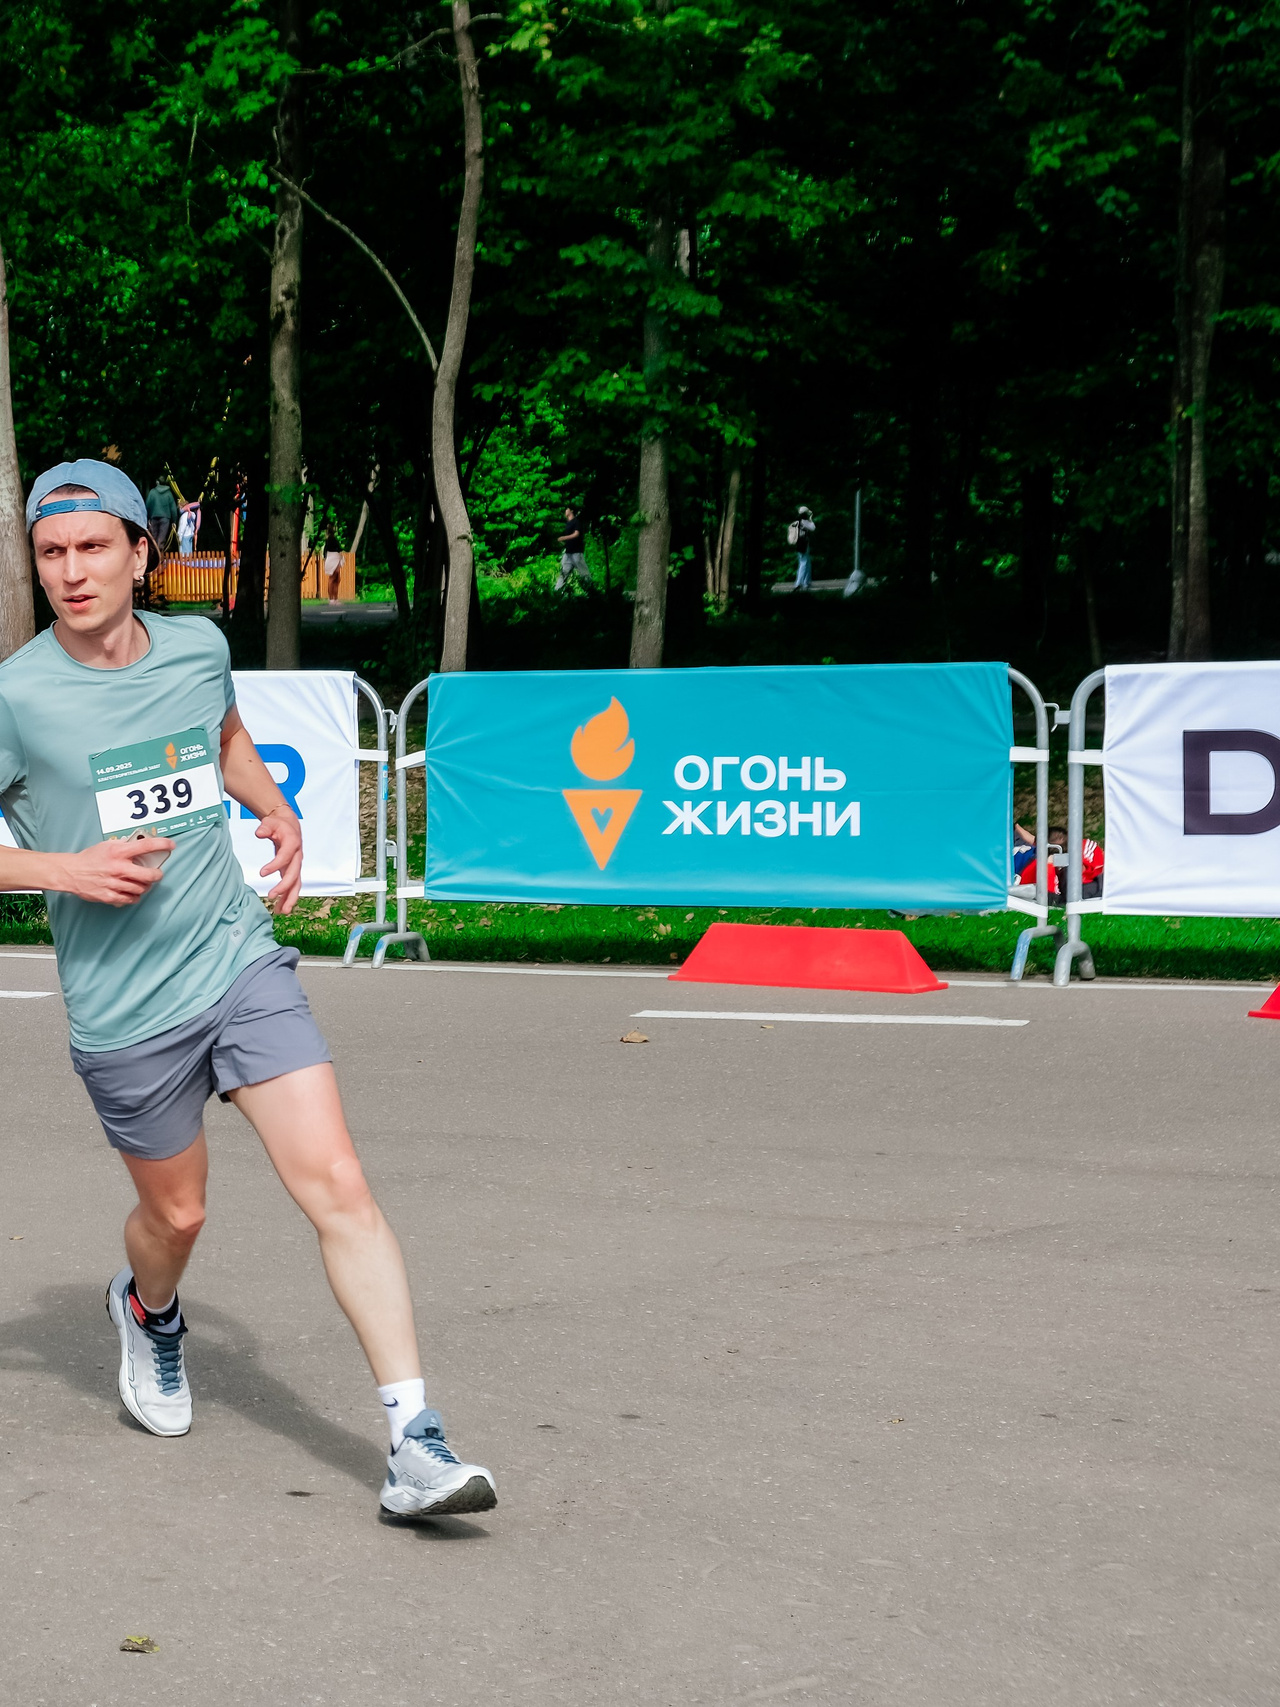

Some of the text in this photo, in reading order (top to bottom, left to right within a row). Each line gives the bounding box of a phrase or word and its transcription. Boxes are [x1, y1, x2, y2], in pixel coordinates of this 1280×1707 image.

[179, 743, 205, 756] ОГОНЬ
[179, 749, 208, 763] ЖИЗНИ
[95, 761, 133, 776] 14.09.2025
[674, 755, 847, 791] ОГОНЬ
[126, 778, 192, 820] 339
[662, 799, 861, 838] ЖИЗНИ
